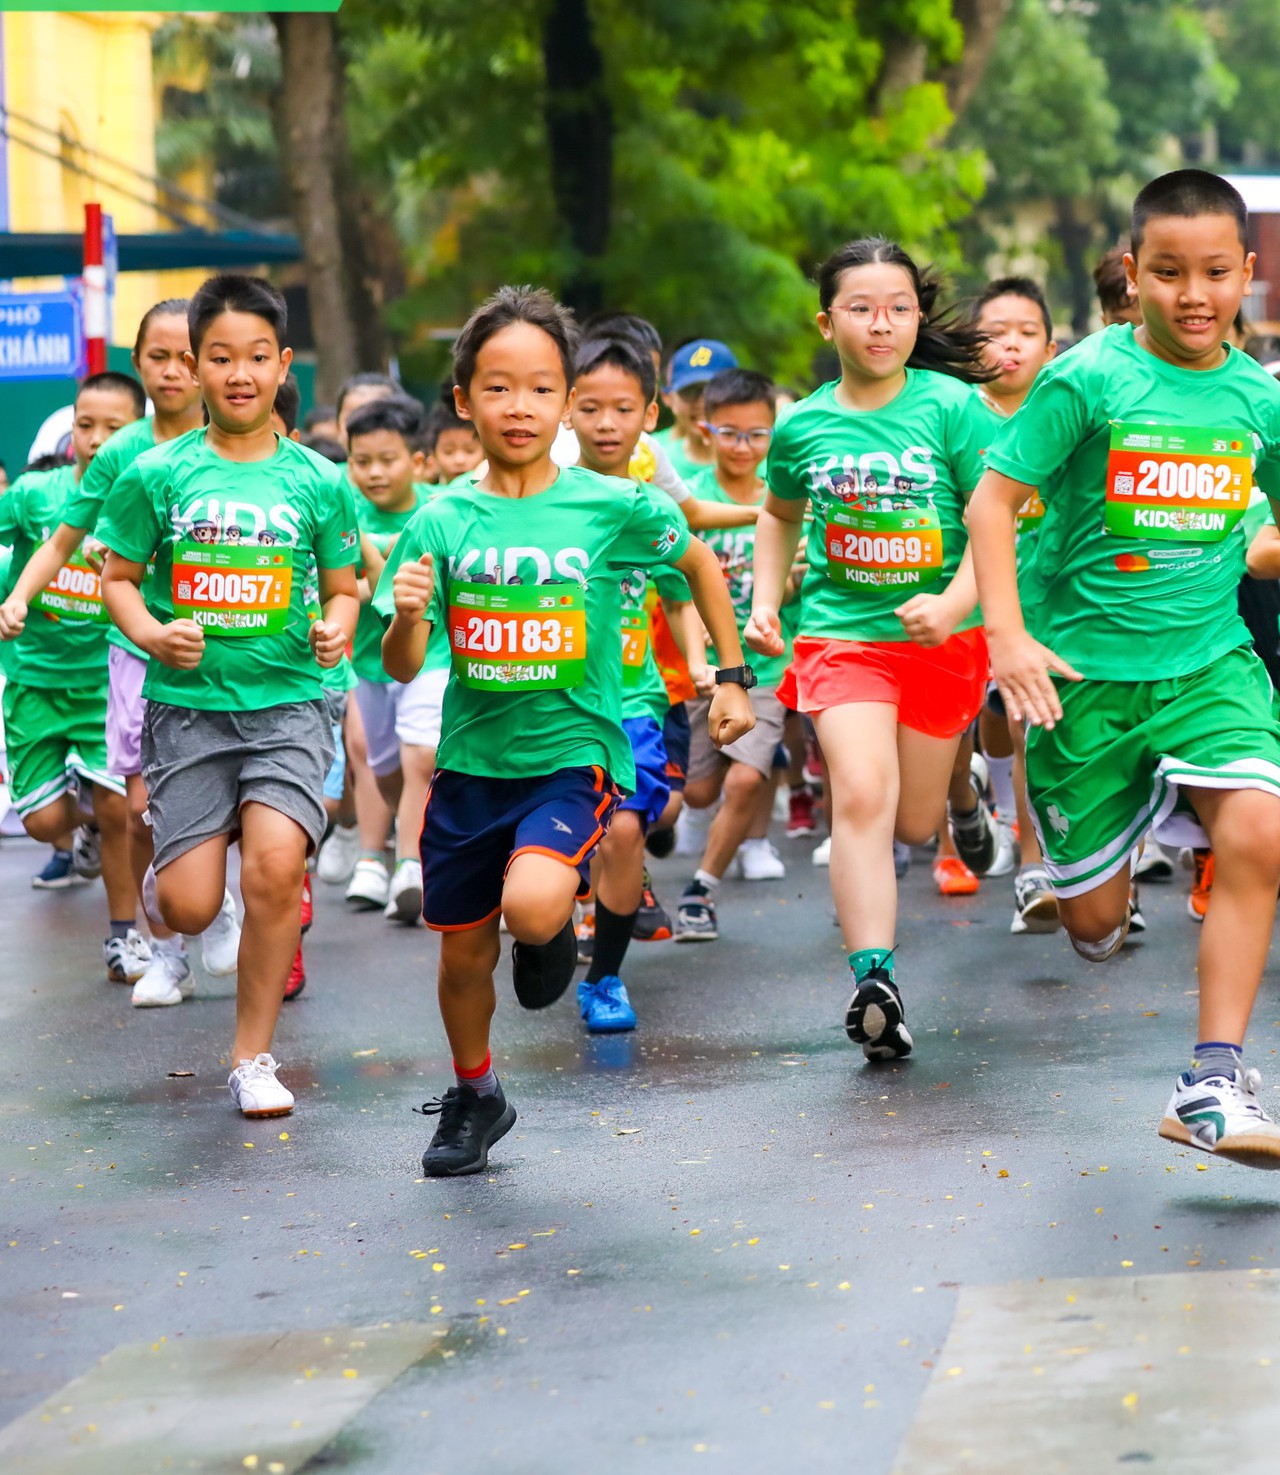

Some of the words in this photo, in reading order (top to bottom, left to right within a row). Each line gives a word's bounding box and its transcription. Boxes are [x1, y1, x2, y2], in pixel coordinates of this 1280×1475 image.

[1136, 459, 1232, 500] 20062
[171, 499, 301, 547] KIDS
[448, 546, 590, 587] KIDS
[844, 533, 922, 564] 20069
[193, 571, 273, 604] 20057
[467, 616, 561, 653] 20183
